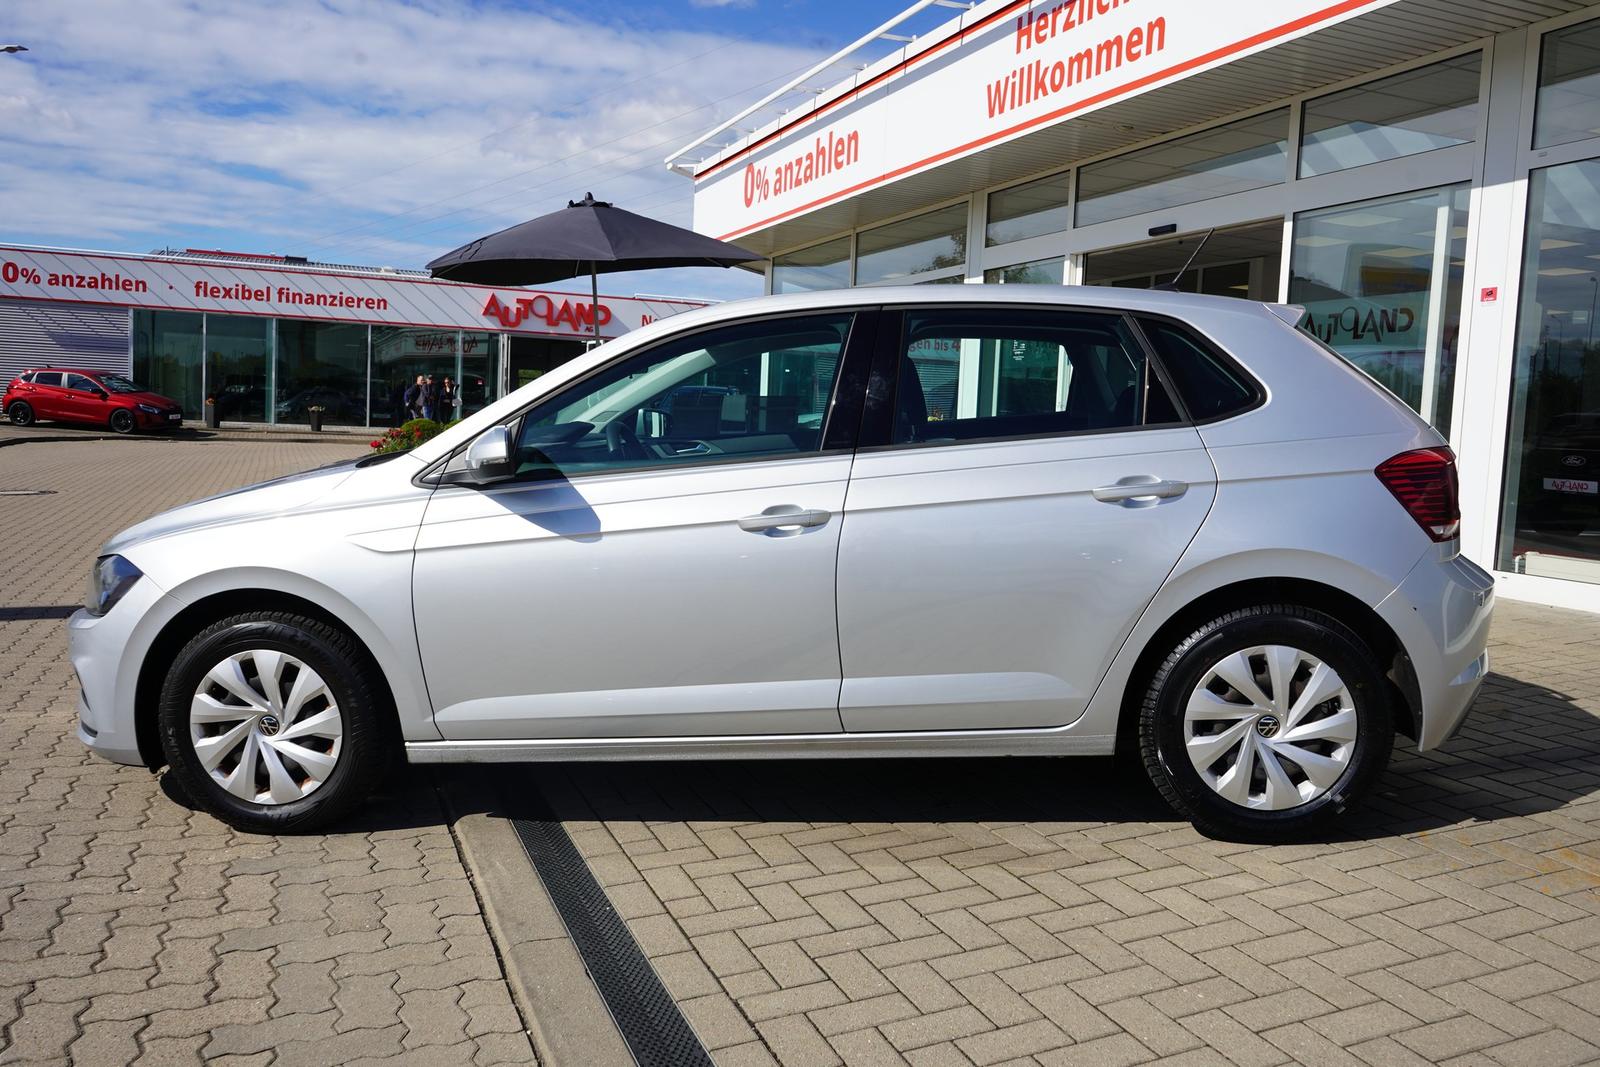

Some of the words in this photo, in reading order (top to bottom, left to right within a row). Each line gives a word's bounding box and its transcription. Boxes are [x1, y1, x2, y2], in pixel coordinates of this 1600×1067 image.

[1016, 0, 1131, 54] Herzl
[986, 16, 1166, 119] Willkommen
[744, 162, 769, 208] 0%
[773, 129, 859, 197] anzahlen
[2, 261, 41, 284] 0%
[47, 272, 147, 293] anzahlen
[194, 280, 271, 302] flexibel
[277, 287, 388, 310] finanzieren
[482, 292, 612, 332] AUTOLAND
[1303, 306, 1414, 345] AUTOLAND
